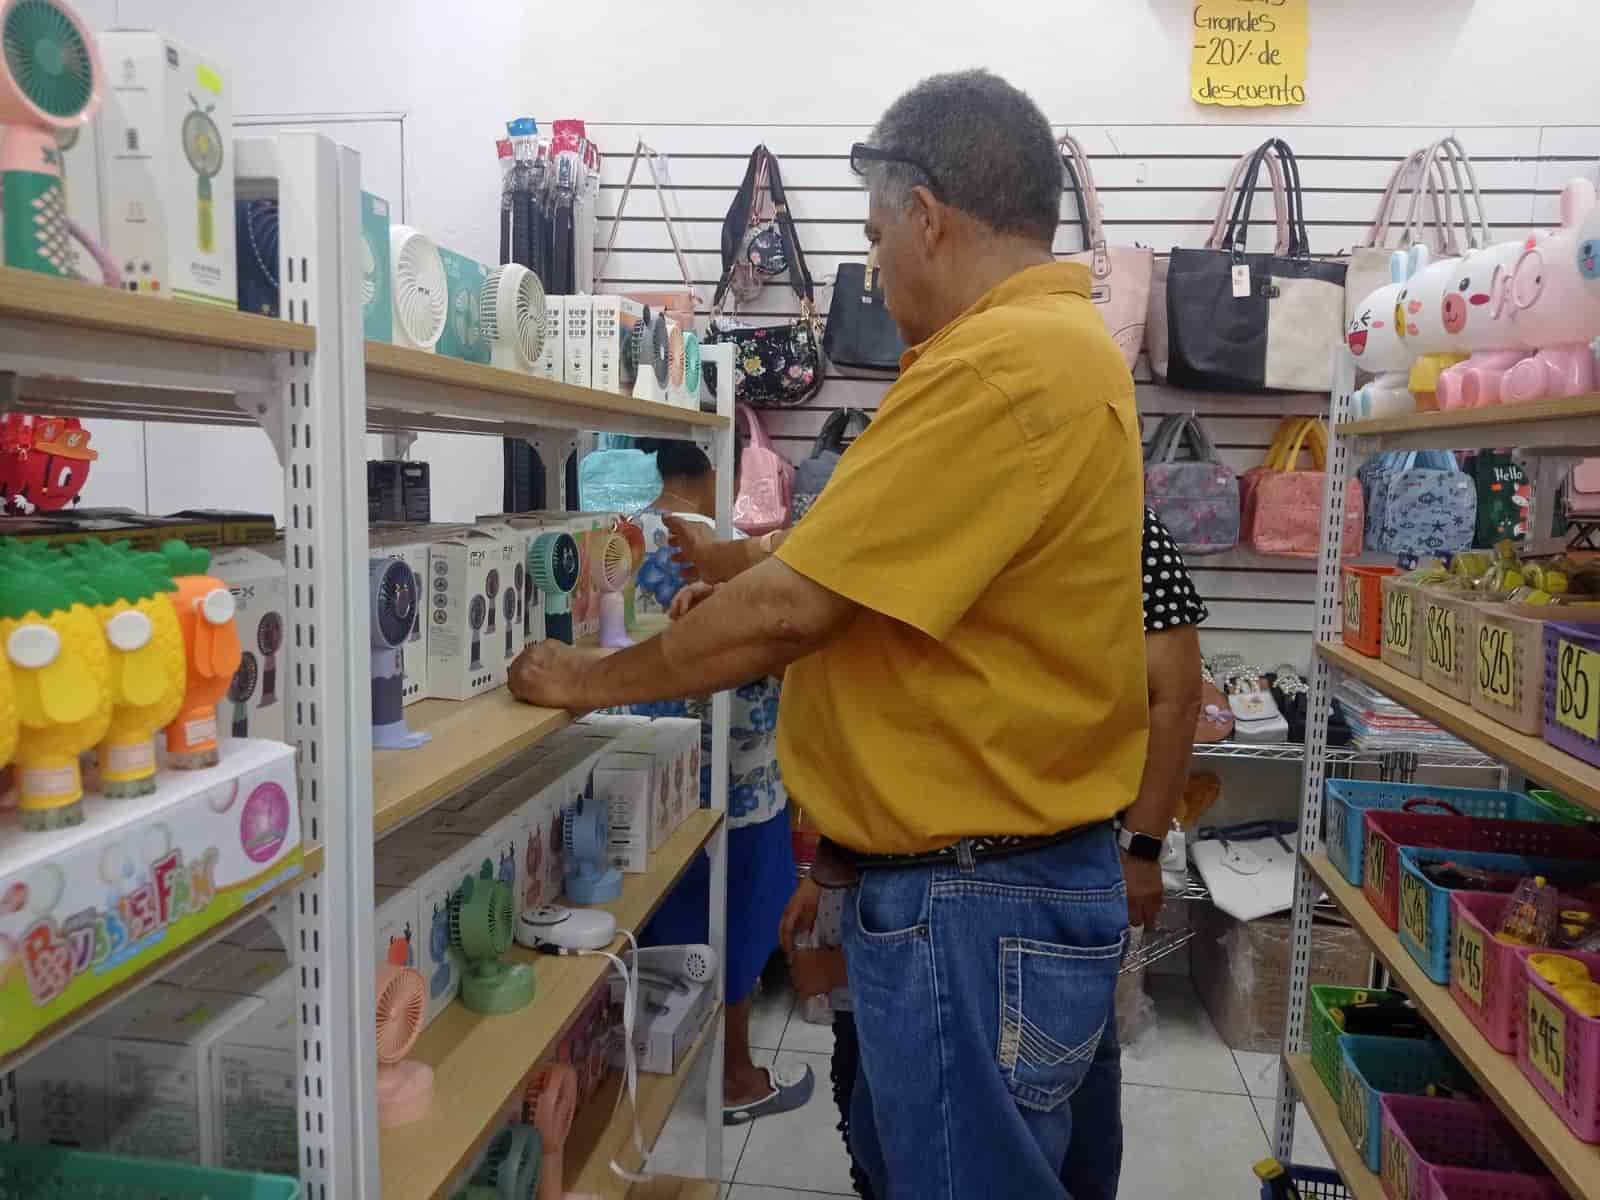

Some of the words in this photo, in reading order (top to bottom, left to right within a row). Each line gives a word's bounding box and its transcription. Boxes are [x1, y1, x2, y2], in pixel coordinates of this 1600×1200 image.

[1193, 4, 1276, 32] Grandes
[1257, 39, 1283, 65] de
[1198, 73, 1305, 102] descuento
[1493, 466, 1523, 481] Hello
[1386, 591, 1409, 648] $65
[1427, 605, 1452, 672] $35
[1479, 626, 1510, 695] $25
[1560, 644, 1589, 720] $5
